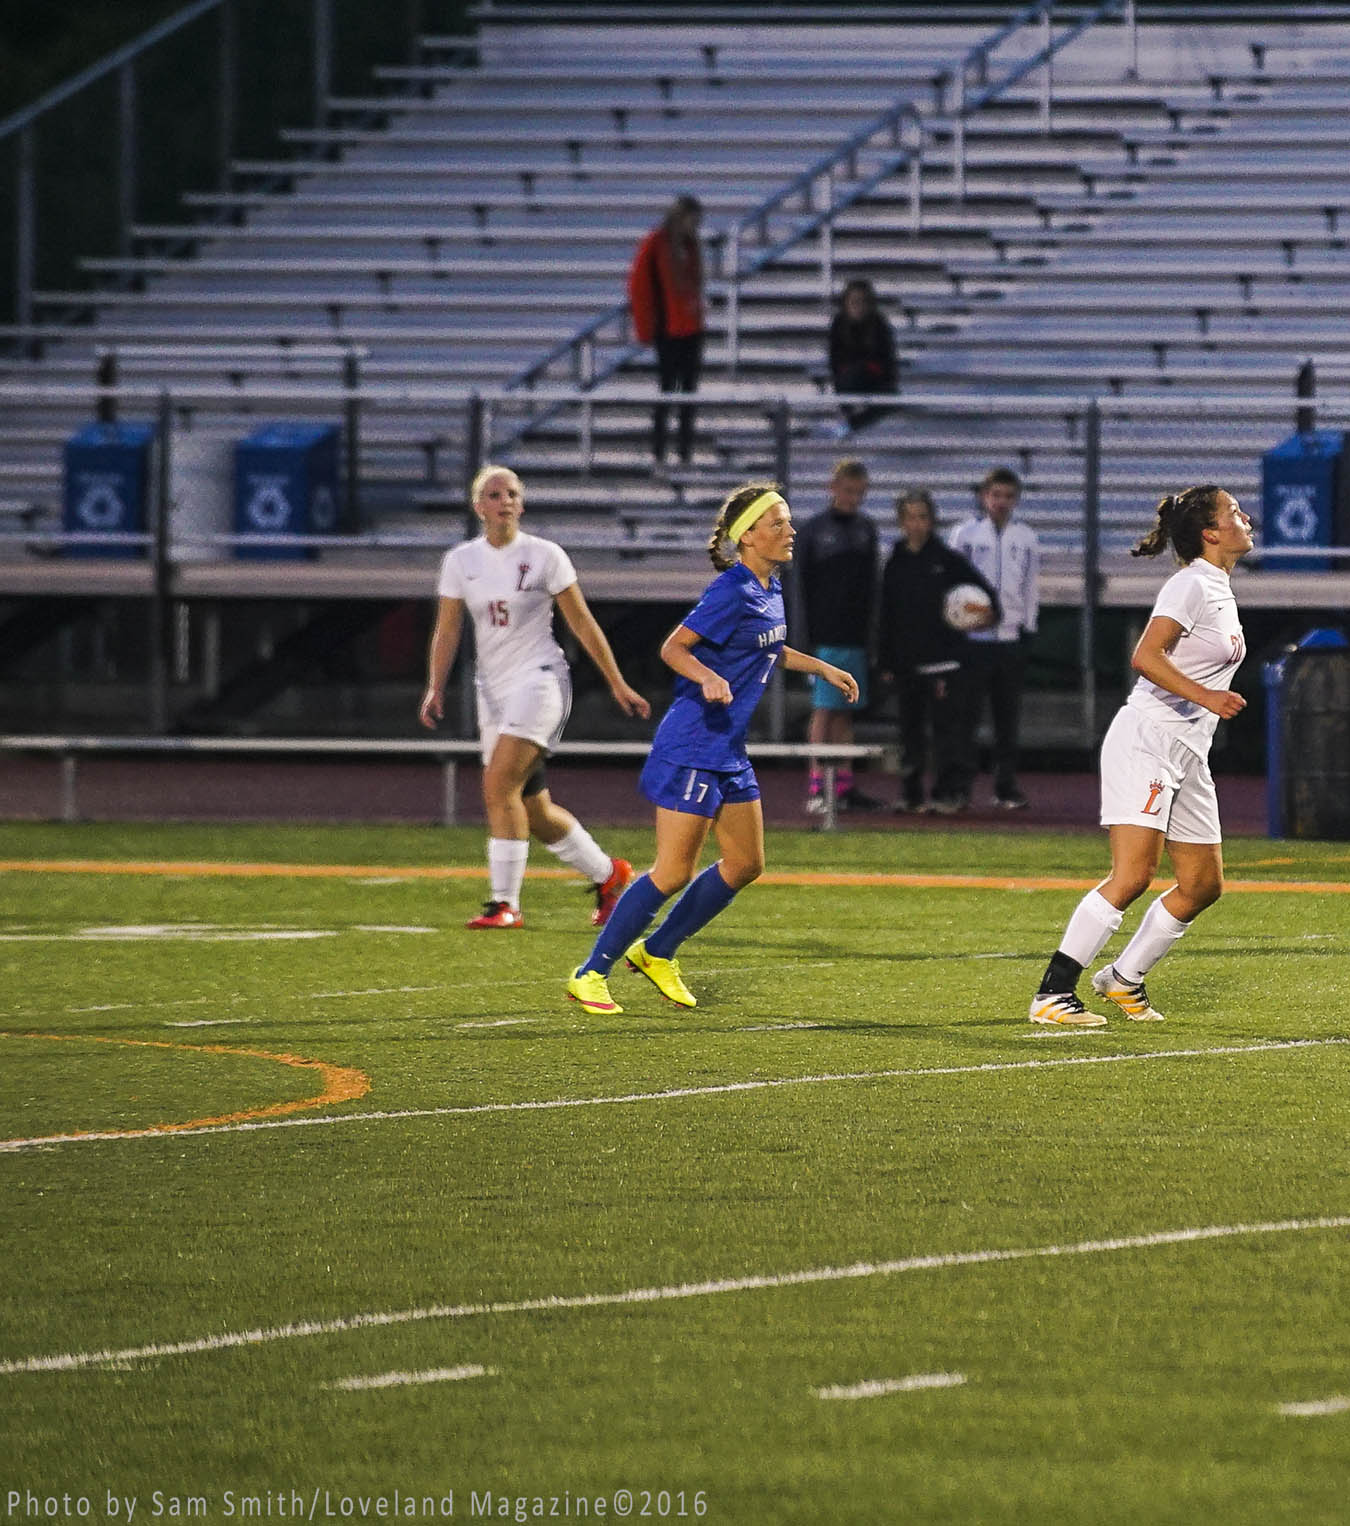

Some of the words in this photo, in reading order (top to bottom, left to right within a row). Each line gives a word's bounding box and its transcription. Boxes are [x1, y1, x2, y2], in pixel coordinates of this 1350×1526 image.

[488, 600, 510, 628] 15
[761, 652, 779, 684] 7
[1139, 786, 1162, 816] L
